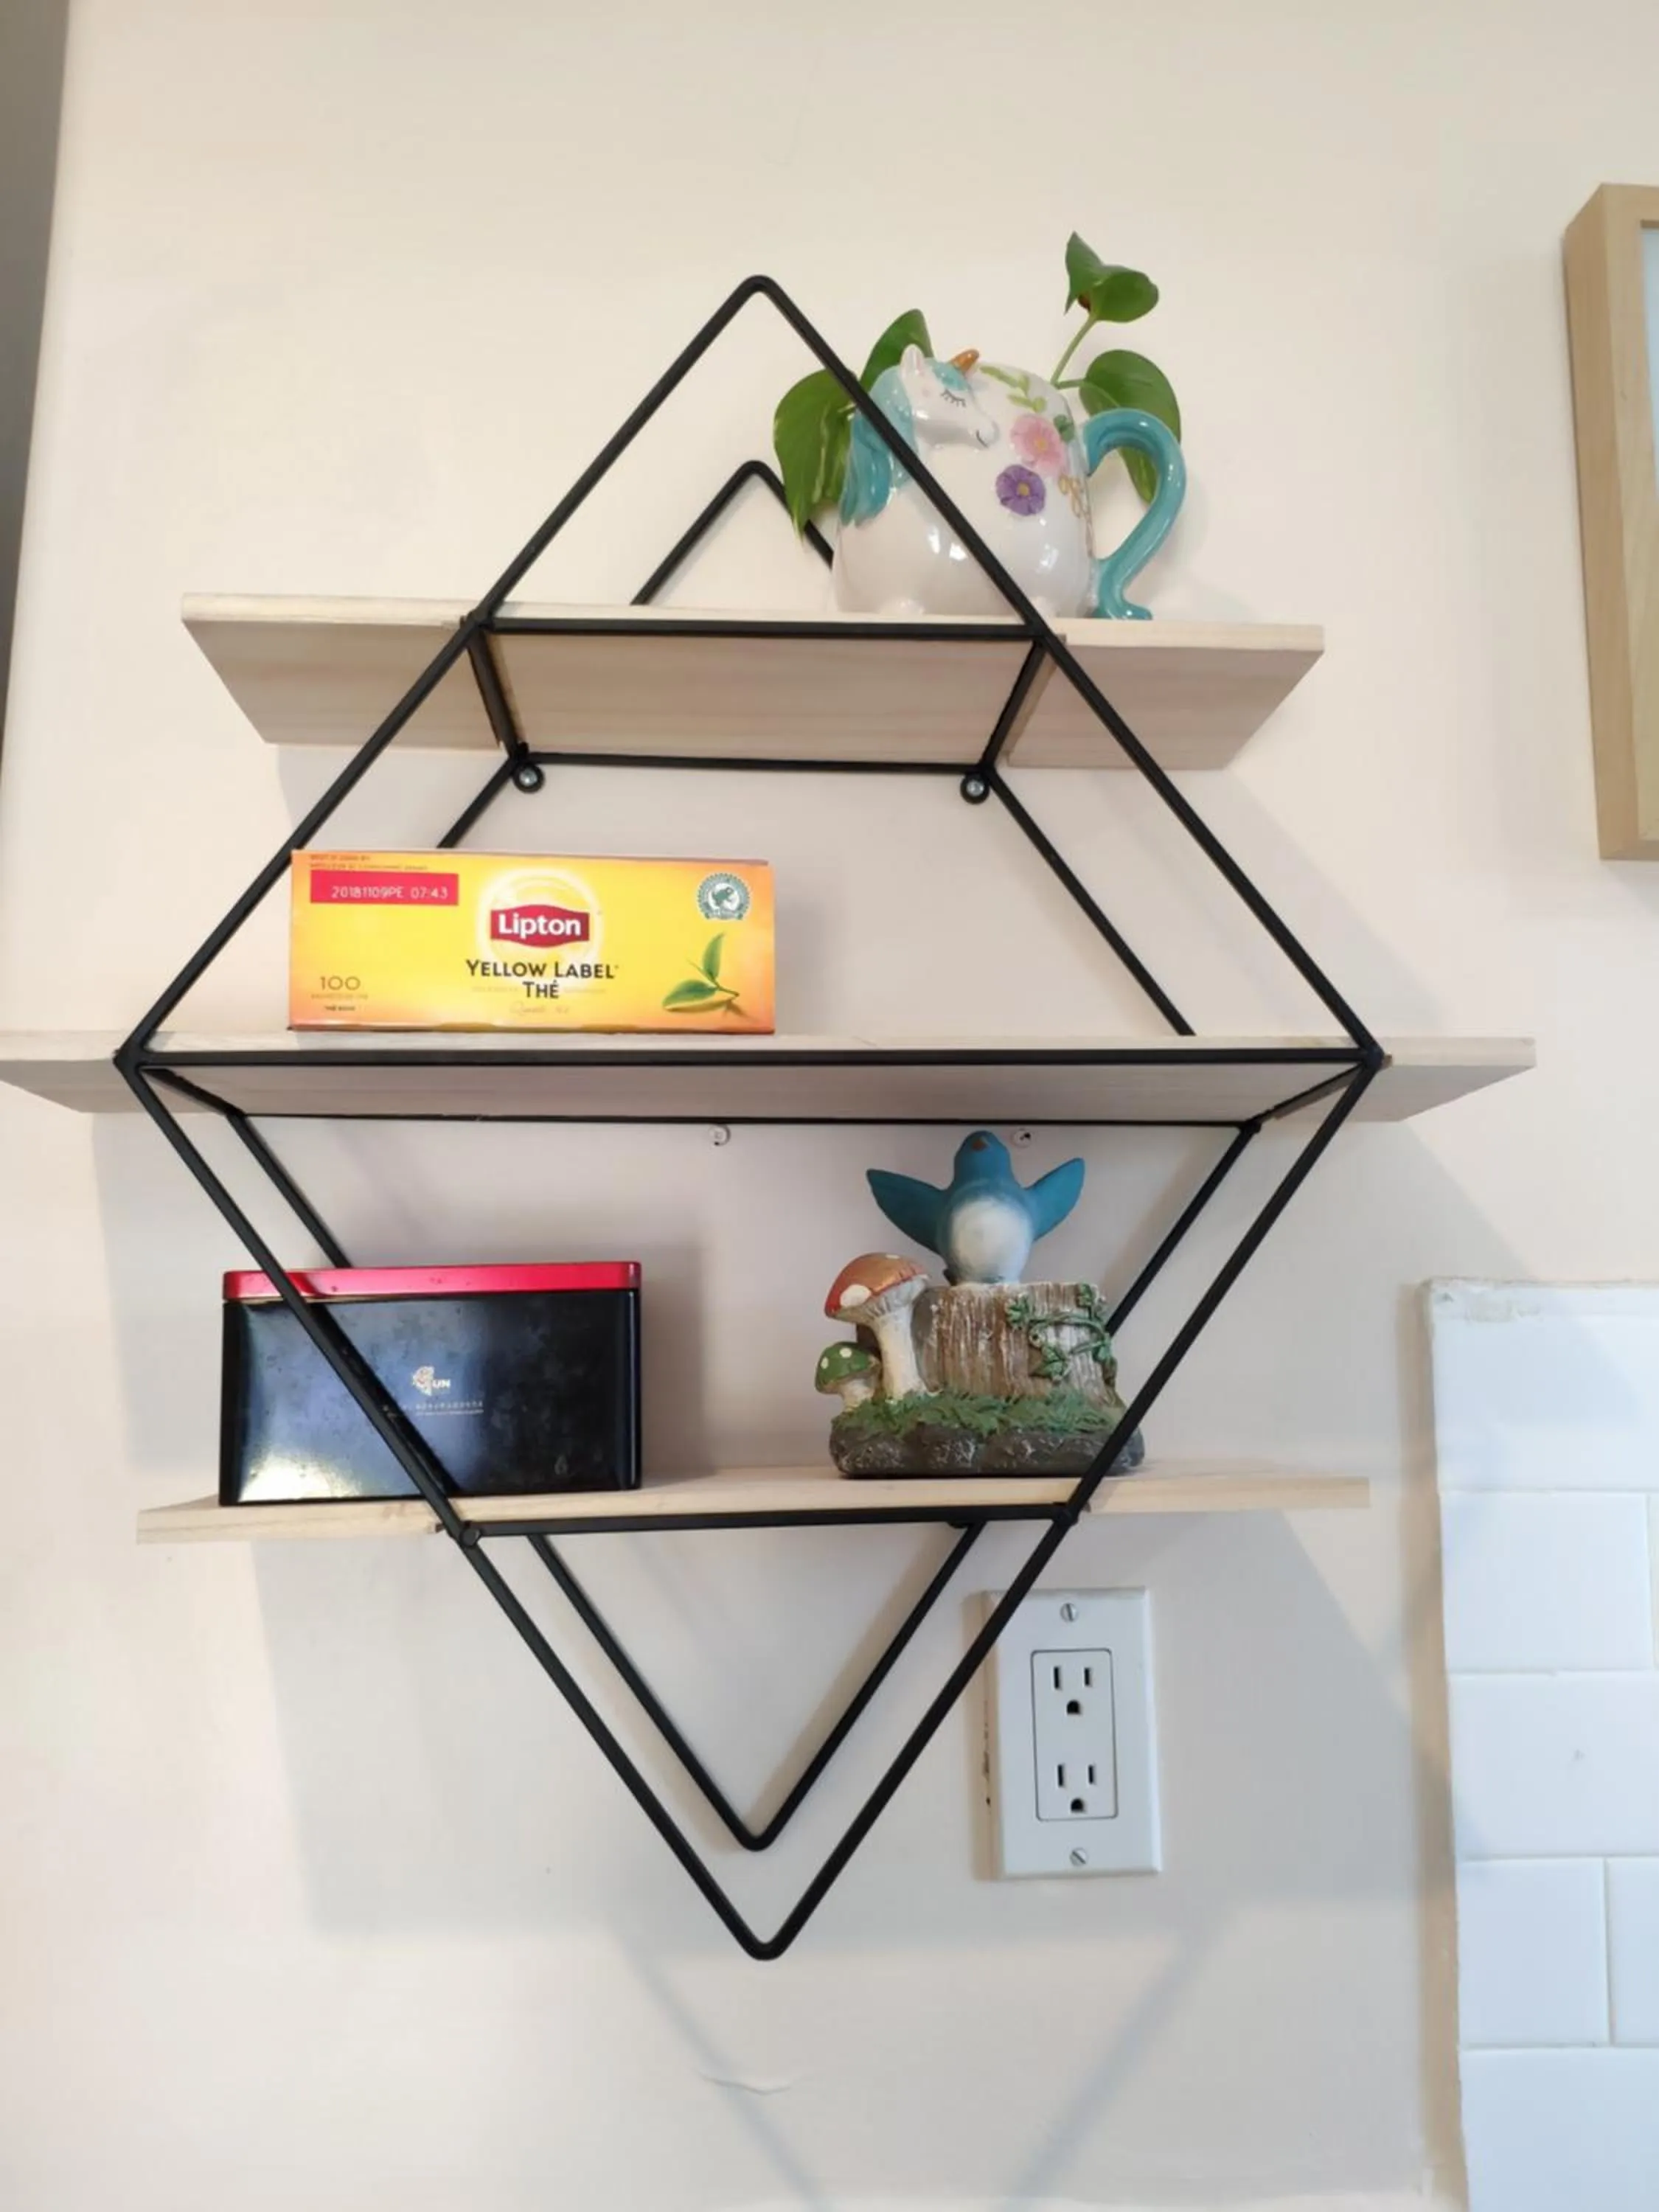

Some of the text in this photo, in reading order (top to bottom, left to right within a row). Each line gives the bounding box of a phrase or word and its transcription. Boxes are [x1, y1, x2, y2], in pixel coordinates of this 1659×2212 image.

[410, 886, 448, 900] 07:43
[498, 912, 581, 939] Lipton
[466, 959, 615, 978] YELLOW LABEL
[319, 975, 361, 990] 100
[522, 980, 560, 998] THÉ
